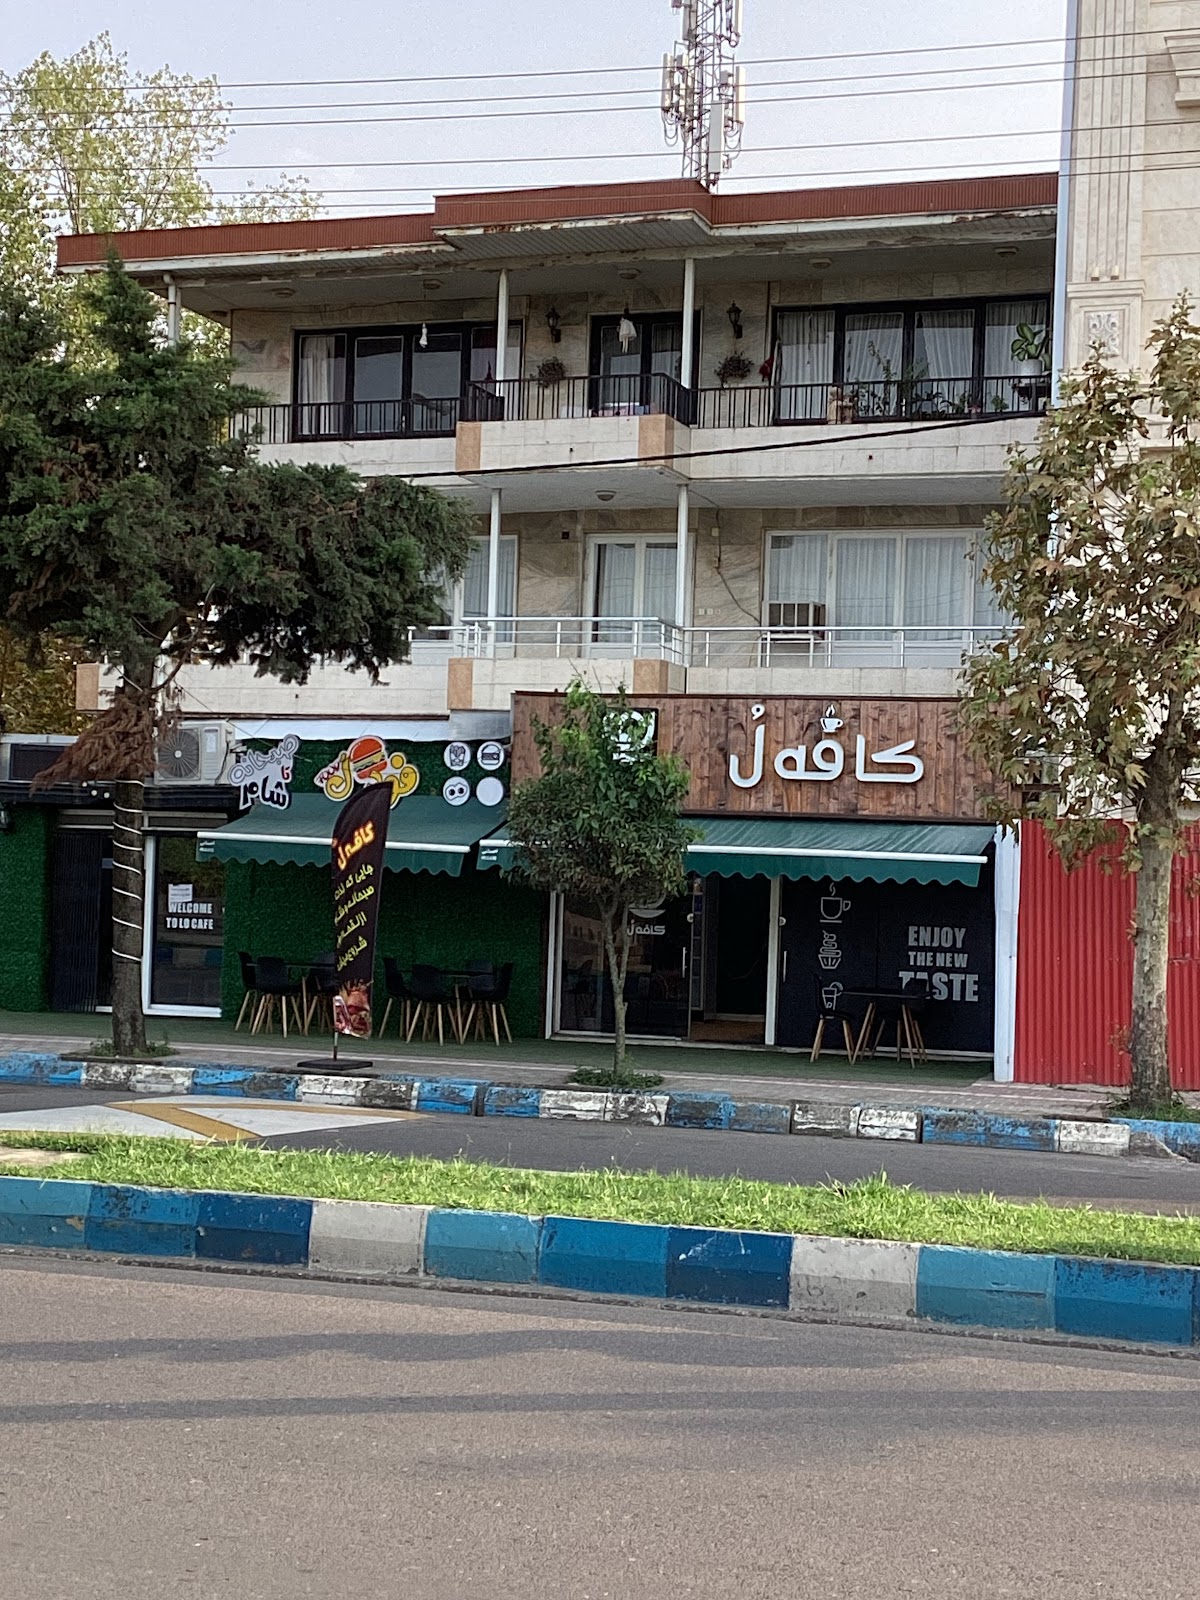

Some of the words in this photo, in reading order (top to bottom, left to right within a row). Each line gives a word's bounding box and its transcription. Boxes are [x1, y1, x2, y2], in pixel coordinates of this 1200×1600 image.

[773, 705, 925, 784] کافه
[242, 775, 287, 807] شام
[169, 902, 213, 914] WELCOME
[191, 918, 214, 930] CAFE
[635, 924, 666, 935] کافه
[908, 925, 967, 949] ENJOY
[908, 951, 934, 967] THE
[936, 952, 968, 968] NEW
